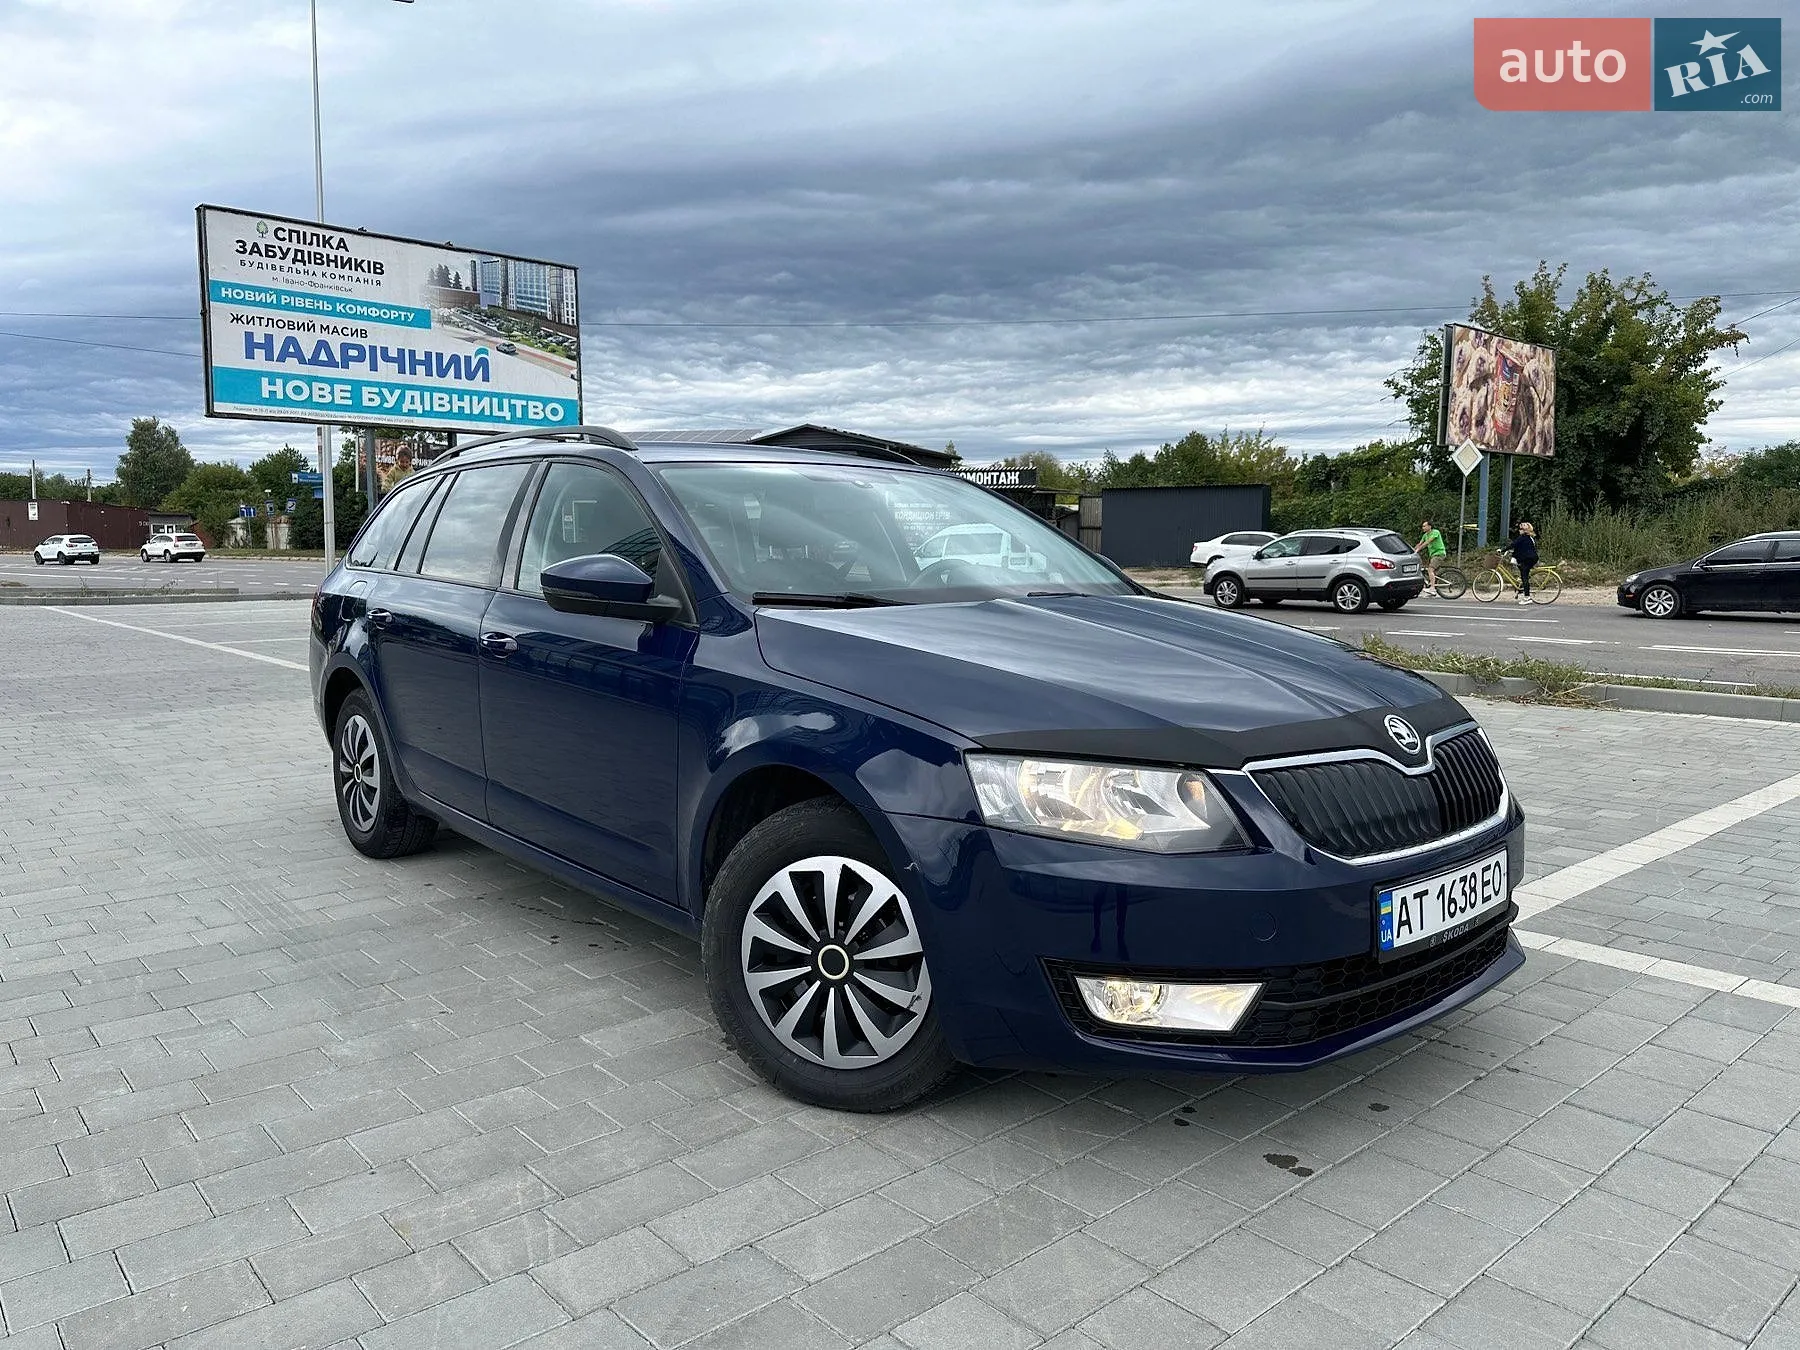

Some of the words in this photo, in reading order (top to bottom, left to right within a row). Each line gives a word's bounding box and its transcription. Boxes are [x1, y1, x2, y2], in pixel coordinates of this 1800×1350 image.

[273, 226, 350, 253] СПІЛКА
[235, 239, 385, 276] ЗАБУДІВНИКІВ
[239, 259, 317, 277] БУДІВЕЛЬНА
[321, 270, 382, 287] КОМПАНІЯ
[282, 276, 353, 293] Івано-Франківськ
[221, 286, 277, 305] НОВИЙ
[281, 294, 332, 311] РІВЕНЬ
[336, 303, 415, 322] КОМФОРТУ
[230, 312, 316, 333] ЖИТЛОВИЙ
[320, 324, 368, 339] МАСИВ
[244, 330, 491, 383] НАДРІЧНИЙ
[261, 376, 353, 405] НОВЕ
[361, 387, 565, 422] БУДІВНИЦТВО
[956, 471, 1020, 485] ОМОНТАЖ
[1396, 888, 1429, 939] AT
[1437, 871, 1478, 923] 1638
[1481, 860, 1502, 905] EO
[1380, 929, 1393, 943] UA
